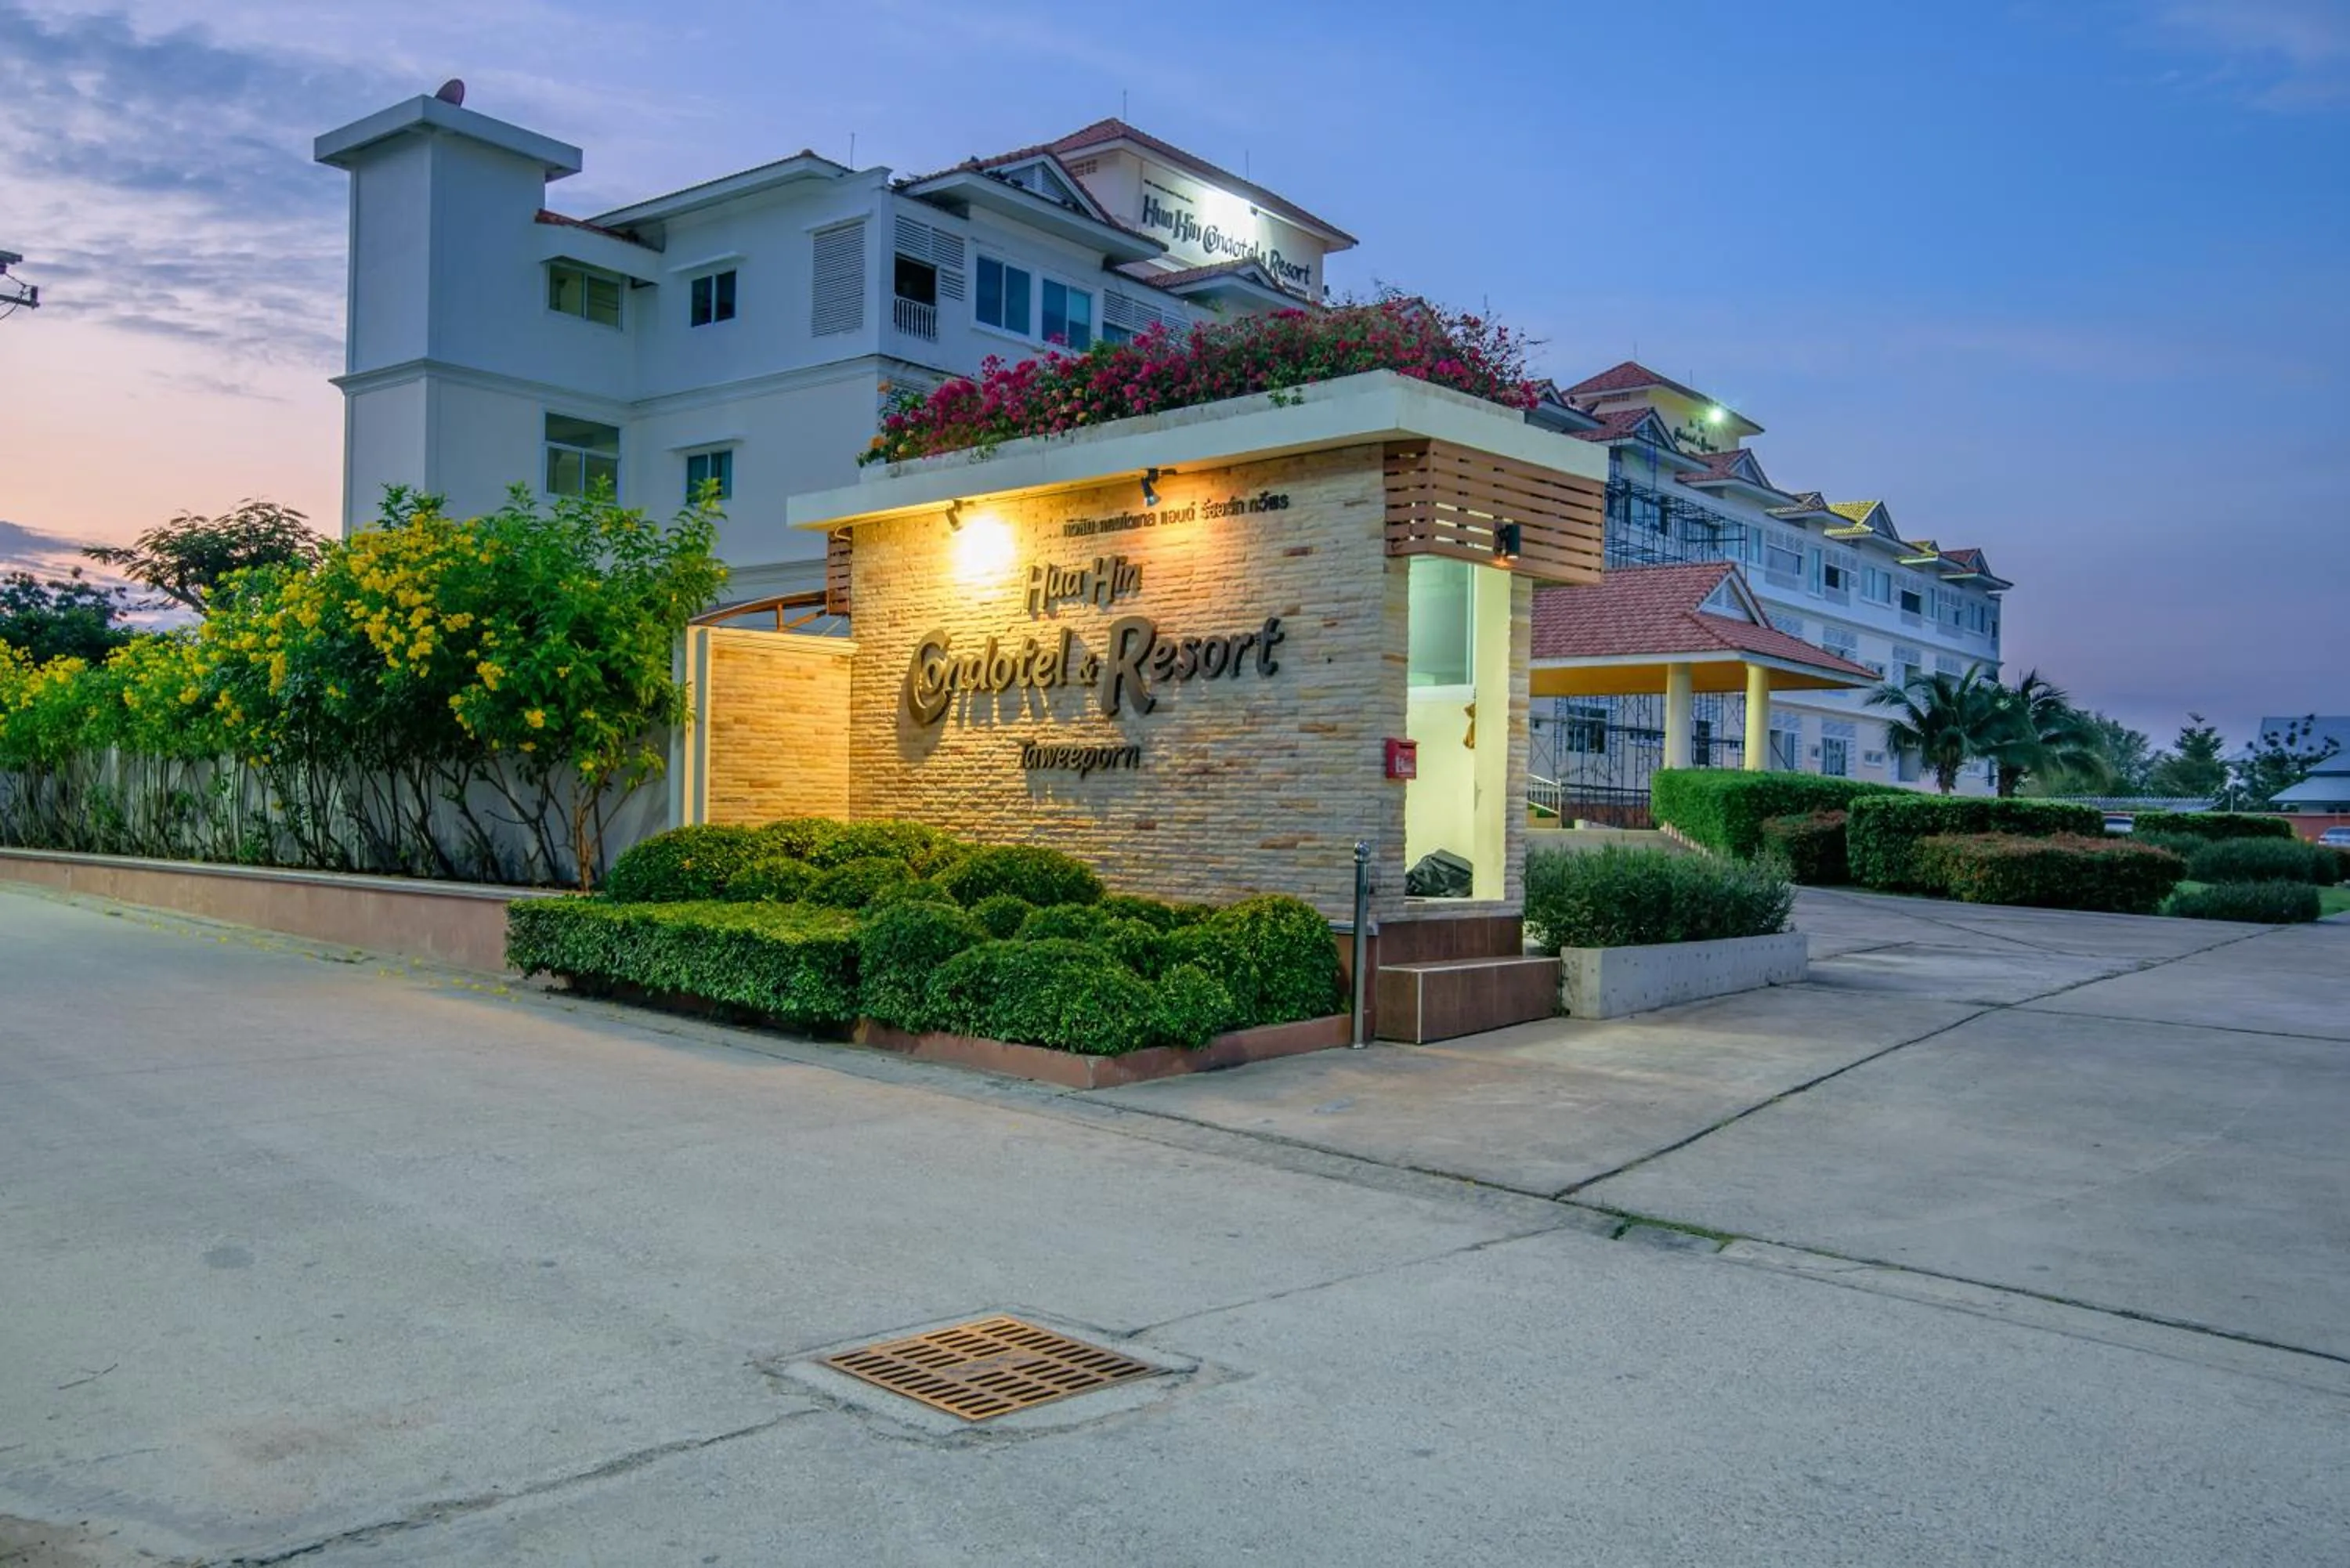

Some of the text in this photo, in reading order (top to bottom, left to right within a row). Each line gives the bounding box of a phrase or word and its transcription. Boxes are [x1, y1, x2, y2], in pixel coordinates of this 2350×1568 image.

[1141, 193, 1173, 229] Hua
[1173, 208, 1201, 243] Hin
[1270, 248, 1311, 285] Resort
[1023, 555, 1143, 613] Hua Hin
[907, 615, 1285, 725] Condotel & Resort
[1019, 739, 1140, 779] Taweeporn
